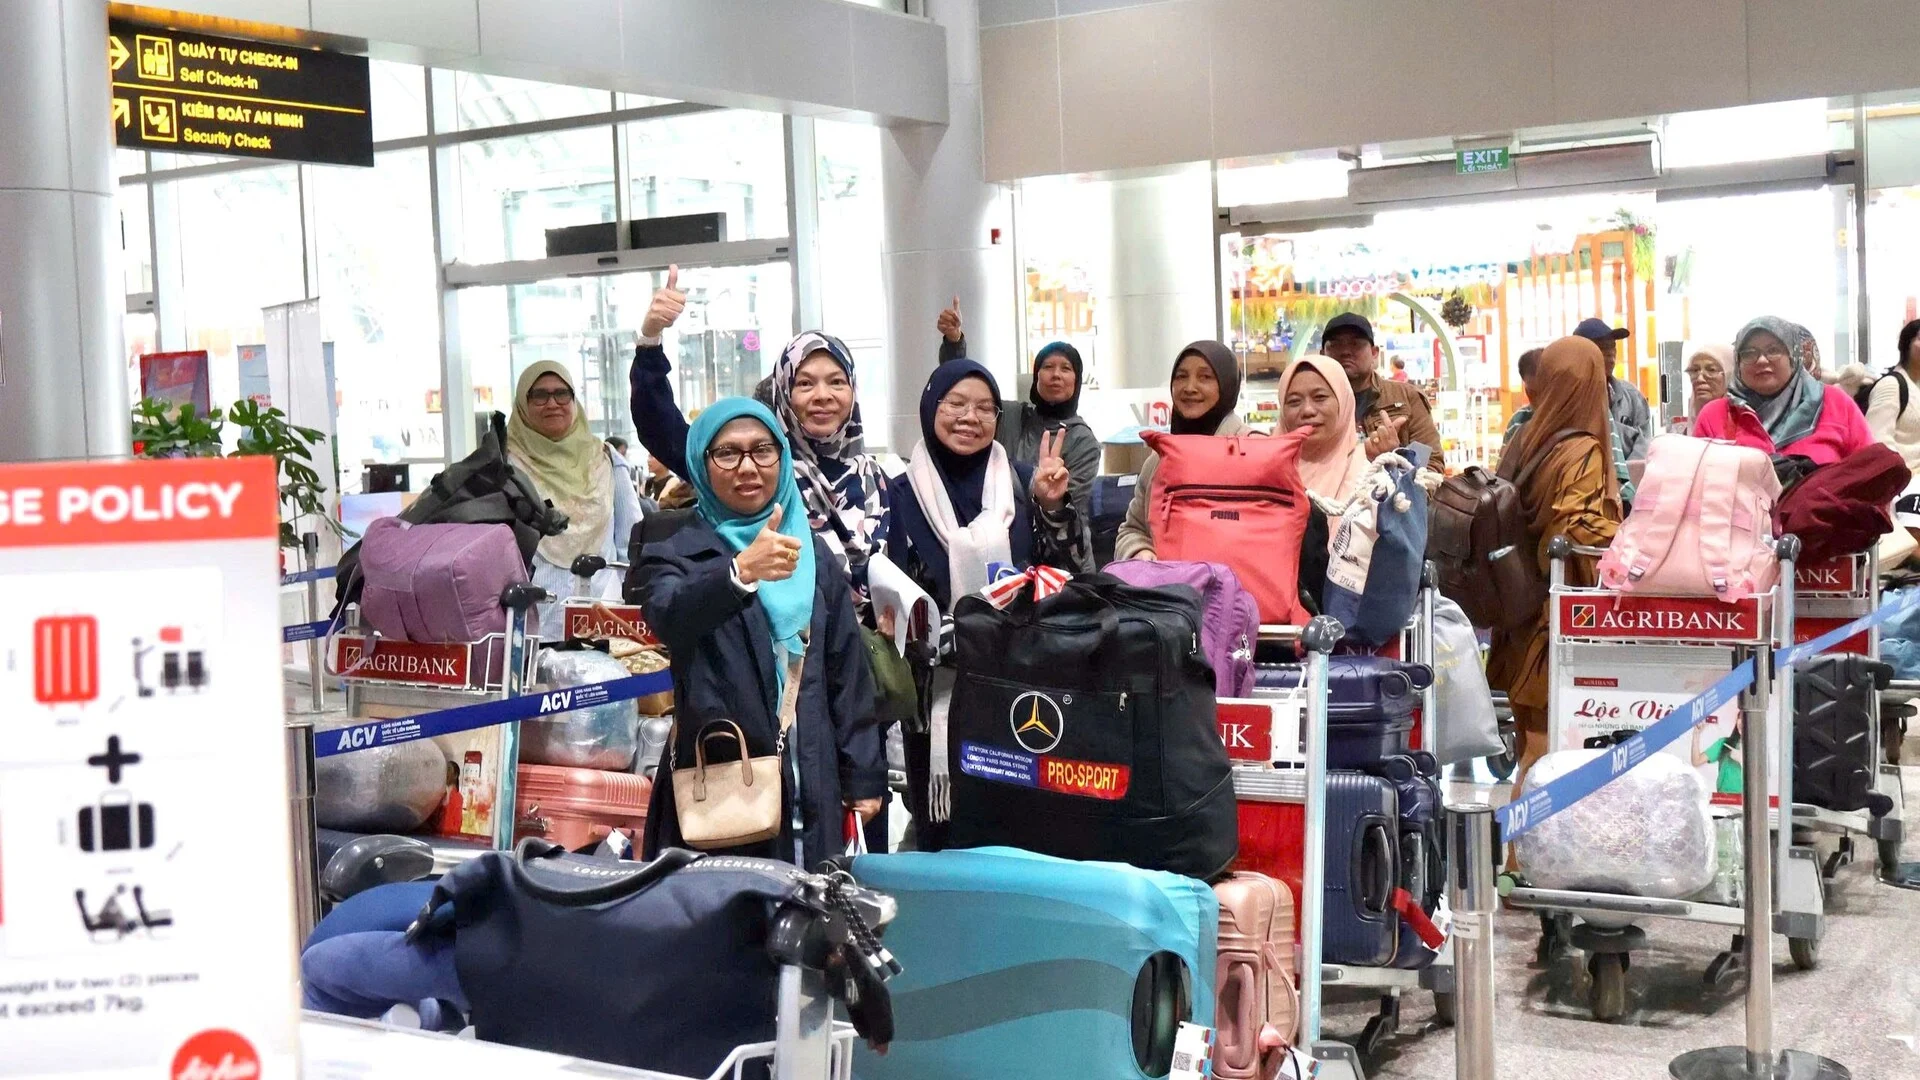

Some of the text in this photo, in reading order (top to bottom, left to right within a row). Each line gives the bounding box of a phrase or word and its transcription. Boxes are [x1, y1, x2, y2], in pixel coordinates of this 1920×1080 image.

[240, 50, 299, 70] CHECK-IN
[180, 67, 259, 90] Self Check-in
[217, 105, 252, 123] SOÁT
[254, 110, 272, 125] AN
[274, 112, 304, 129] NINH
[183, 128, 272, 150] Security Check
[1463, 149, 1503, 165] EXIT
[57, 481, 244, 525] POLICY
[1210, 510, 1240, 521] PUMA
[1600, 609, 1745, 632] AGRIBANK
[363, 653, 458, 677] AGRIBANK
[540, 690, 572, 713] ACV
[336, 725, 377, 750] ACV
[1611, 744, 1628, 775] ACV
[1048, 761, 1119, 791] PRO-SPORT
[1506, 799, 1529, 837] ACV
[16, 998, 96, 1018] exceed
